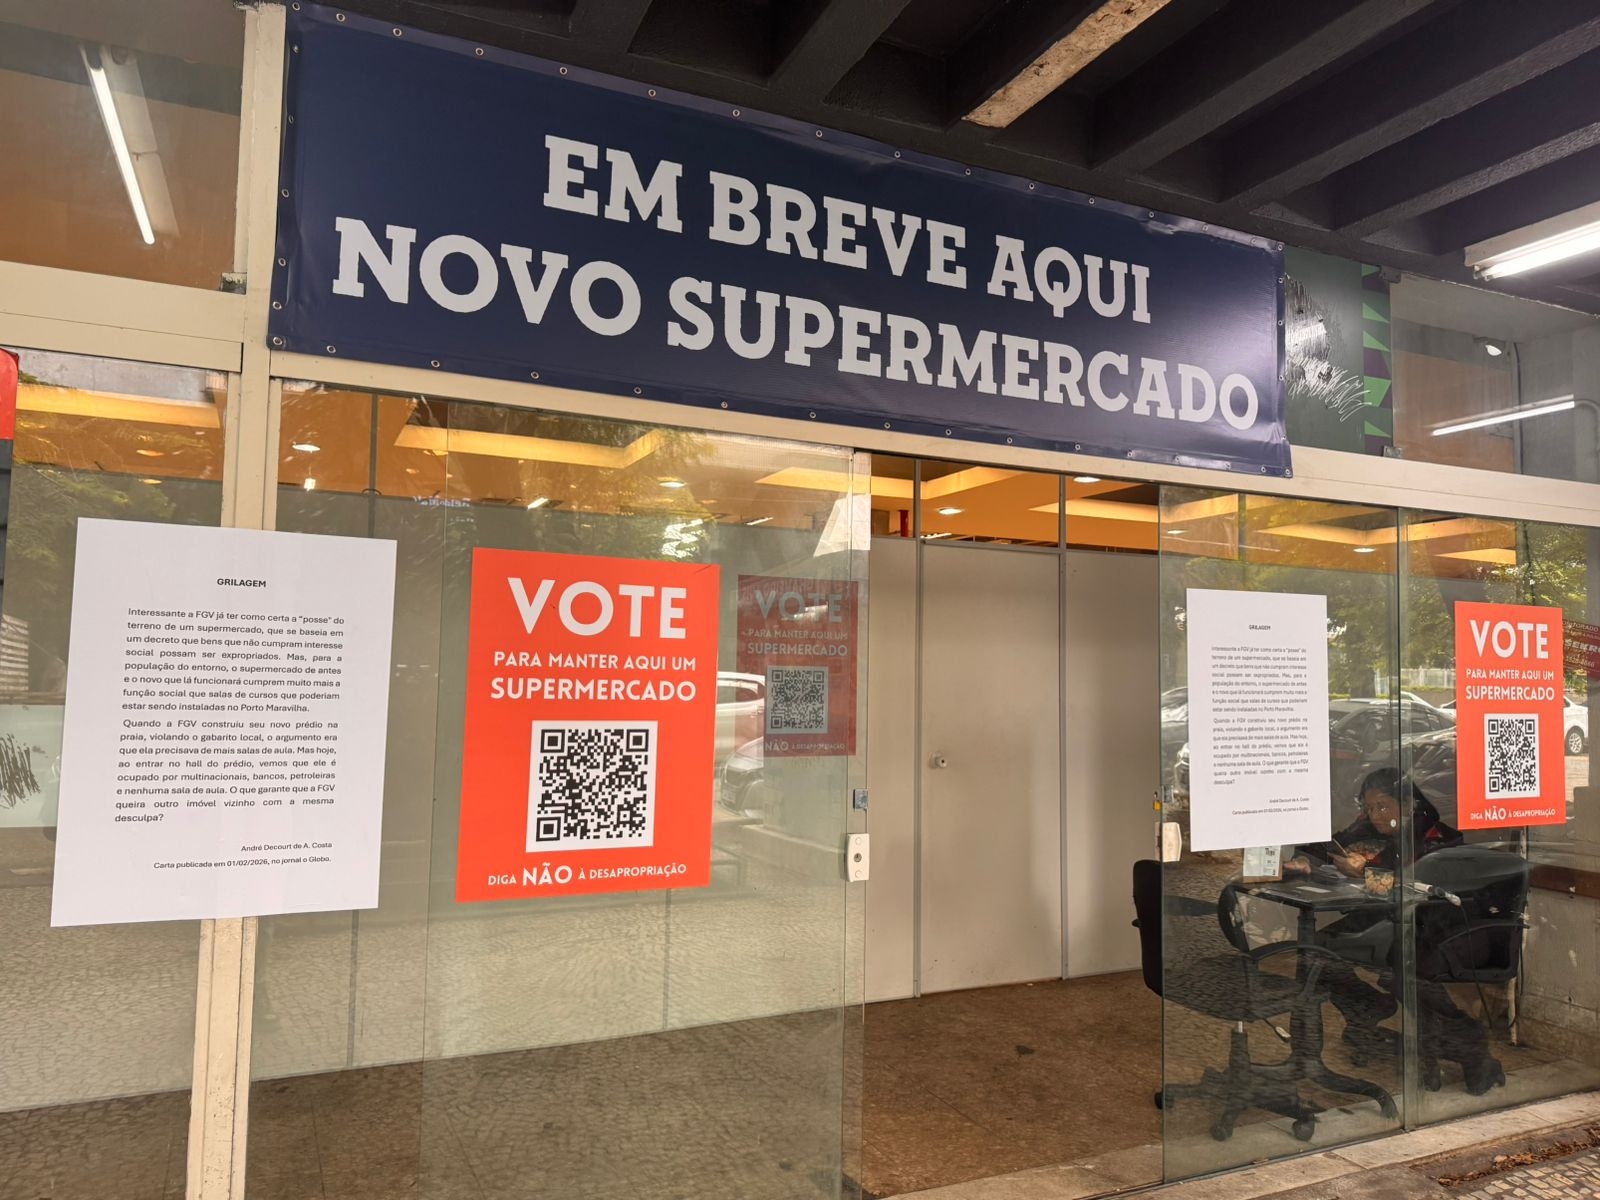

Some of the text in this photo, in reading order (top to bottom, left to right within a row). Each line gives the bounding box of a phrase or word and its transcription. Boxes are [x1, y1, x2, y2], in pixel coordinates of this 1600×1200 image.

[543, 134, 1151, 324] EM BREVE AQUI
[332, 216, 1258, 430] NOVO SUPERMERCADO
[216, 578, 266, 587] GRILAGEM
[505, 576, 687, 640] VOTE
[754, 590, 842, 623] VOTE
[128, 608, 186, 617] Interessante
[195, 610, 214, 618] FGV
[215, 611, 224, 620] já
[127, 622, 161, 630] terreno
[197, 625, 264, 634] supermercado,
[299, 628, 327, 636] baseia
[749, 628, 847, 640] PARA MANTER AQUI UM
[143, 635, 179, 643] decreto
[200, 637, 222, 645] bens
[242, 638, 259, 646] não
[304, 641, 343, 649] interesse
[1469, 619, 1548, 659] VOTE
[125, 648, 153, 656] social
[159, 650, 196, 658] possam
[221, 652, 280, 660] expropriados.
[286, 653, 306, 661] Mas,
[748, 642, 847, 656] SUPERMERCADO
[124, 662, 174, 671] população
[191, 664, 228, 672] entorno,
[493, 650, 696, 671] PARA MANTER AQUI UM
[1466, 668, 1553, 680] PARA MANTER AQUI UM
[123, 688, 155, 697] função
[158, 689, 186, 697] social
[208, 690, 232, 698] salas
[234, 690, 246, 698] de
[280, 692, 296, 700] que
[299, 692, 339, 700] poderiam
[490, 676, 696, 701] SUPERMERCADO
[1465, 684, 1554, 700] SUPERMERCADO
[178, 703, 225, 711] instaladas
[240, 703, 264, 711] Porto
[265, 704, 309, 712] Maravilha.
[122, 719, 161, 728] Quando
[177, 719, 197, 727] FGV
[201, 720, 244, 728] construiu
[295, 721, 322, 729] prédio
[119, 733, 146, 741] praia,
[200, 733, 237, 742] gabarito
[239, 733, 264, 741] local,
[275, 734, 321, 742] argumento
[118, 747, 137, 755] que
[138, 746, 153, 754] ela
[155, 747, 199, 755] precisava
[261, 746, 272, 754] de
[316, 746, 336, 755] hoje,
[765, 738, 788, 751] NÃO
[185, 759, 202, 767] hall
[223, 759, 254, 768] prédio,
[330, 758, 336, 766] é
[117, 773, 159, 782] ocupado
[162, 774, 178, 782] por
[180, 773, 249, 781] multinacionais,
[290, 772, 335, 780] petroleiras
[115, 801, 145, 809] queira
[186, 799, 216, 807] imóvel
[223, 799, 255, 807] vizinho
[114, 813, 164, 822] desculpa?
[1471, 812, 1483, 820] DIGA
[1484, 805, 1506, 820] NÃO
[1513, 807, 1555, 819] DESAPROPRIAÇÃO
[175, 861, 212, 869] publicada
[281, 856, 301, 864] jornal
[487, 860, 687, 887] DIGA NÃO À DESAPROPRIAÇÃO
